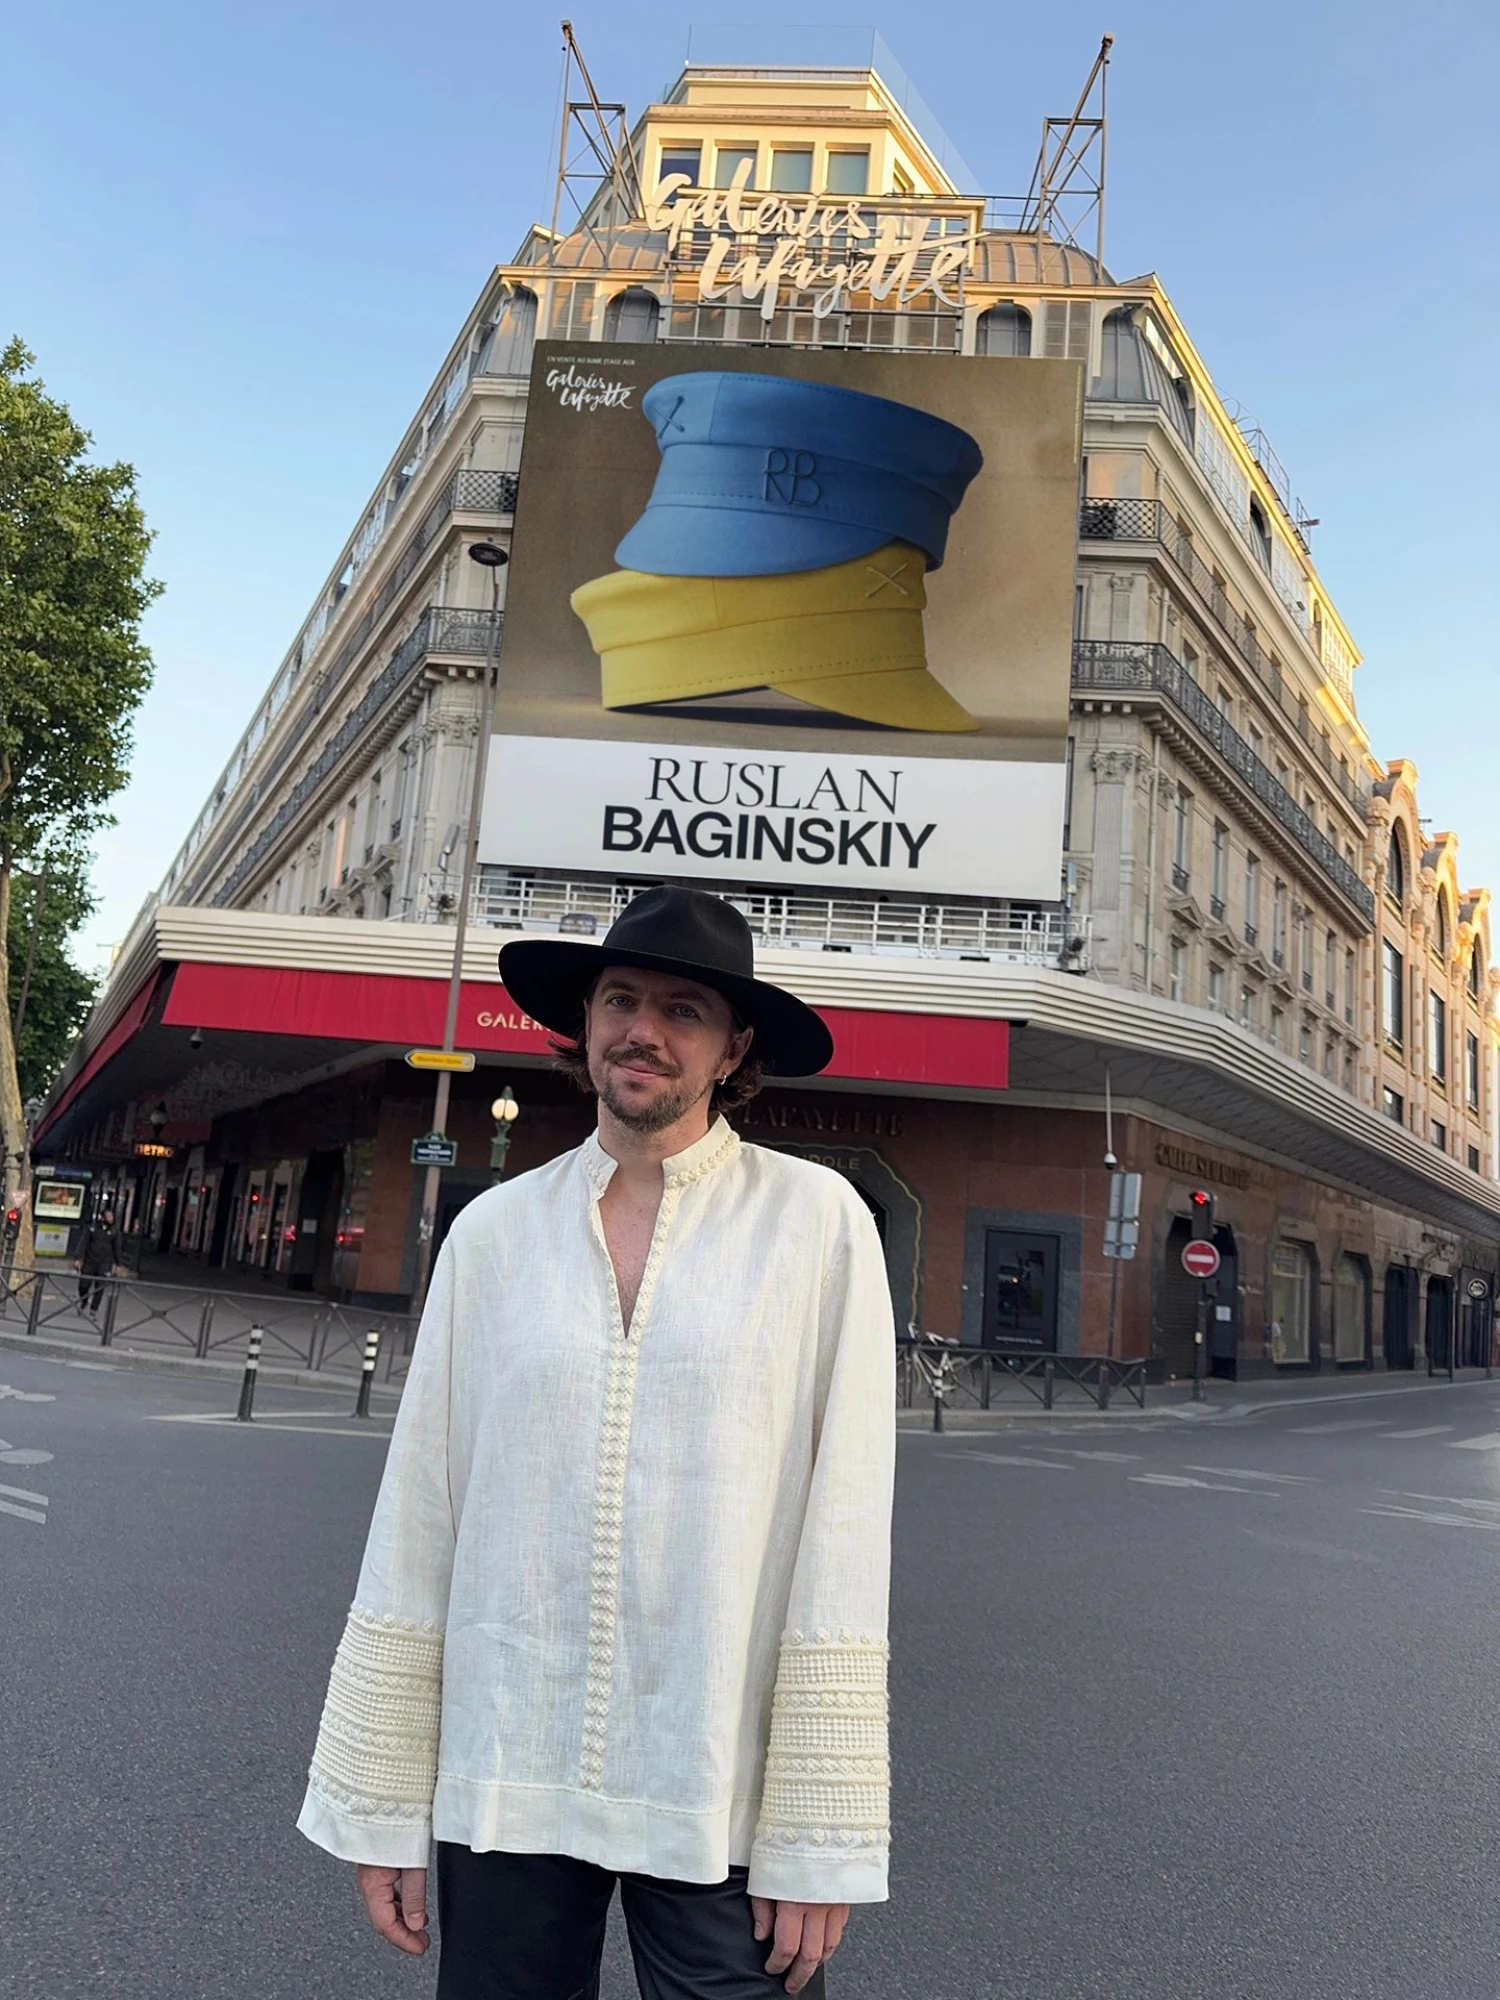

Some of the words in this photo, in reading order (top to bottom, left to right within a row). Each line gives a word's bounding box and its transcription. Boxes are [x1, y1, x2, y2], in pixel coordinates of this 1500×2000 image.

[645, 157, 870, 252] Galeries
[699, 216, 991, 321] Lafayette
[546, 364, 606, 393] Galeries
[560, 382, 637, 412] Lafayette
[763, 447, 822, 507] RB
[645, 757, 904, 815] RUSLAN
[602, 805, 937, 869] BAGINSKIY
[476, 1011, 551, 1031] GALER
